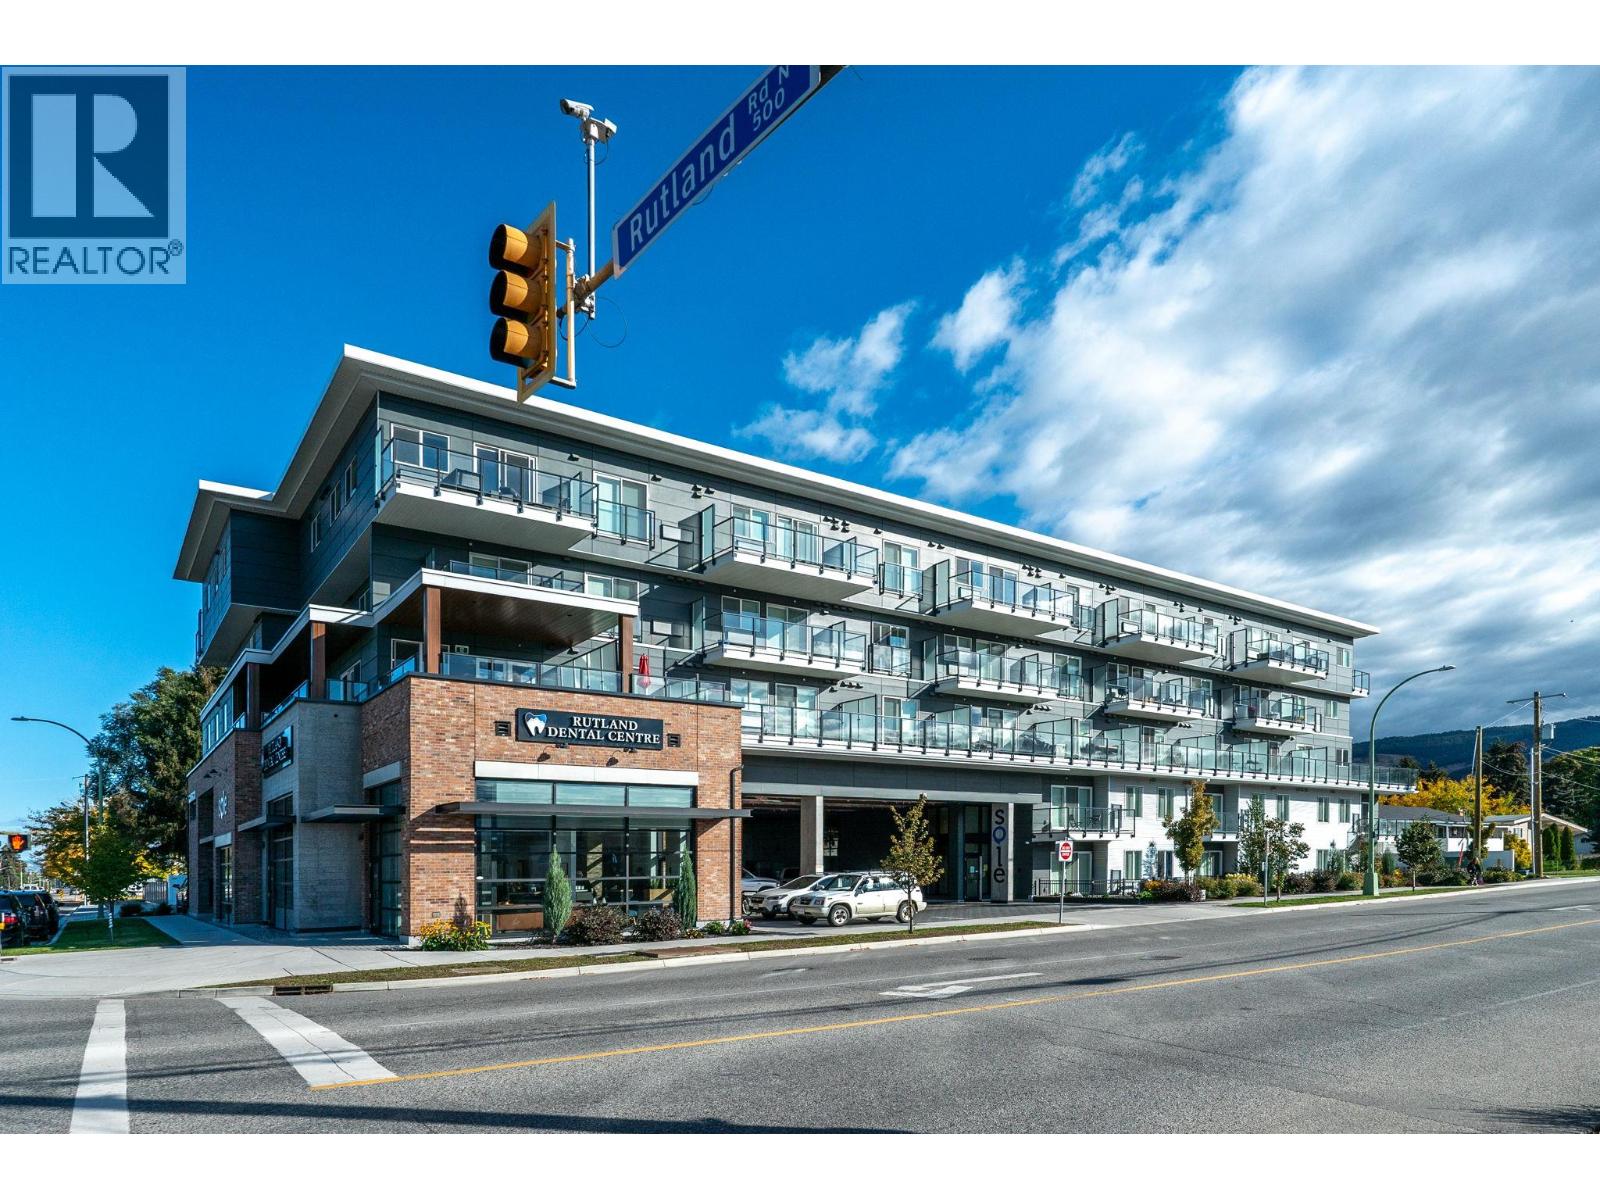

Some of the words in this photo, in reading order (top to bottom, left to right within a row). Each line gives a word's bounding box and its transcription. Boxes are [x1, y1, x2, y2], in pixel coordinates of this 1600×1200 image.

[748, 78, 769, 114] Rd
[778, 65, 789, 85] N
[753, 87, 785, 131] 500
[629, 112, 736, 252] Rutland
[547, 726, 605, 741] DENTAL
[607, 731, 661, 744] CENTRE
[572, 716, 638, 731] RUTLAND
